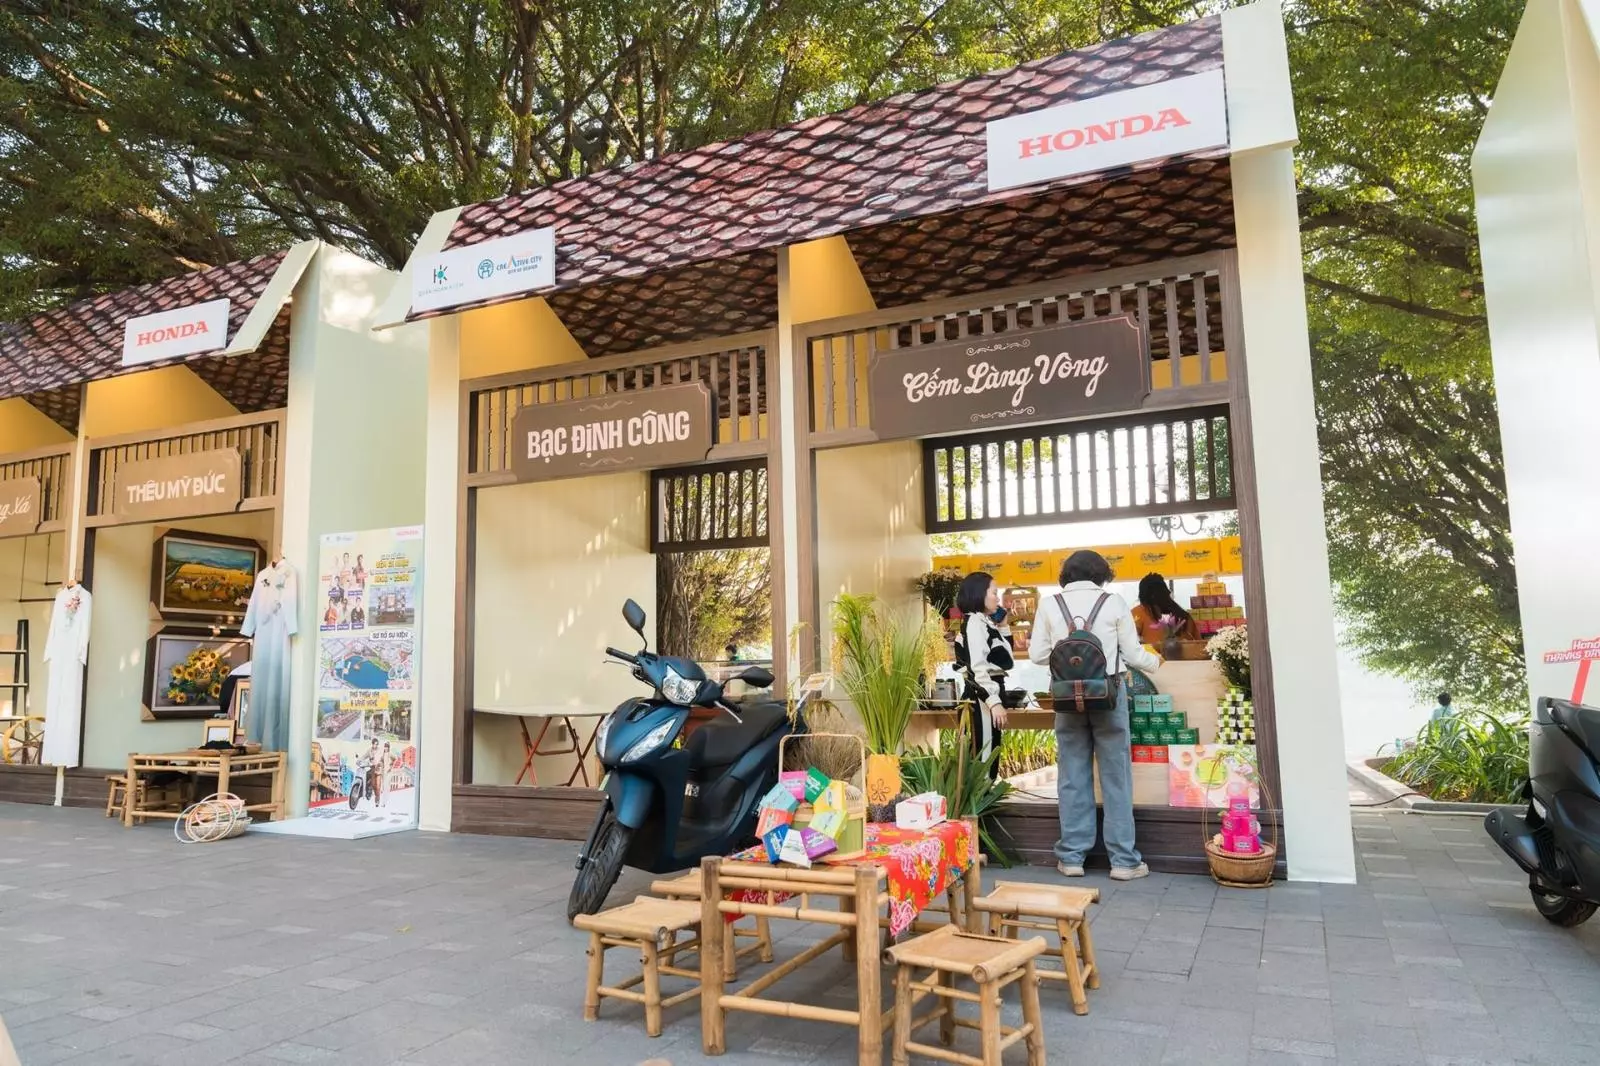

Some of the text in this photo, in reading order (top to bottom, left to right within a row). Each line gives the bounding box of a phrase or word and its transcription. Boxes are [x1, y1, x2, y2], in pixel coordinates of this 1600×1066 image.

[1018, 108, 1191, 159] HONDA
[136, 320, 209, 346] HONDA
[902, 352, 1109, 407] Cốm Làng Vòng
[527, 409, 691, 463] BẠC ĐỊNH CÔNG
[126, 469, 226, 503] THÊU MỸ ĐỨC
[1546, 651, 1582, 661] THANKS
